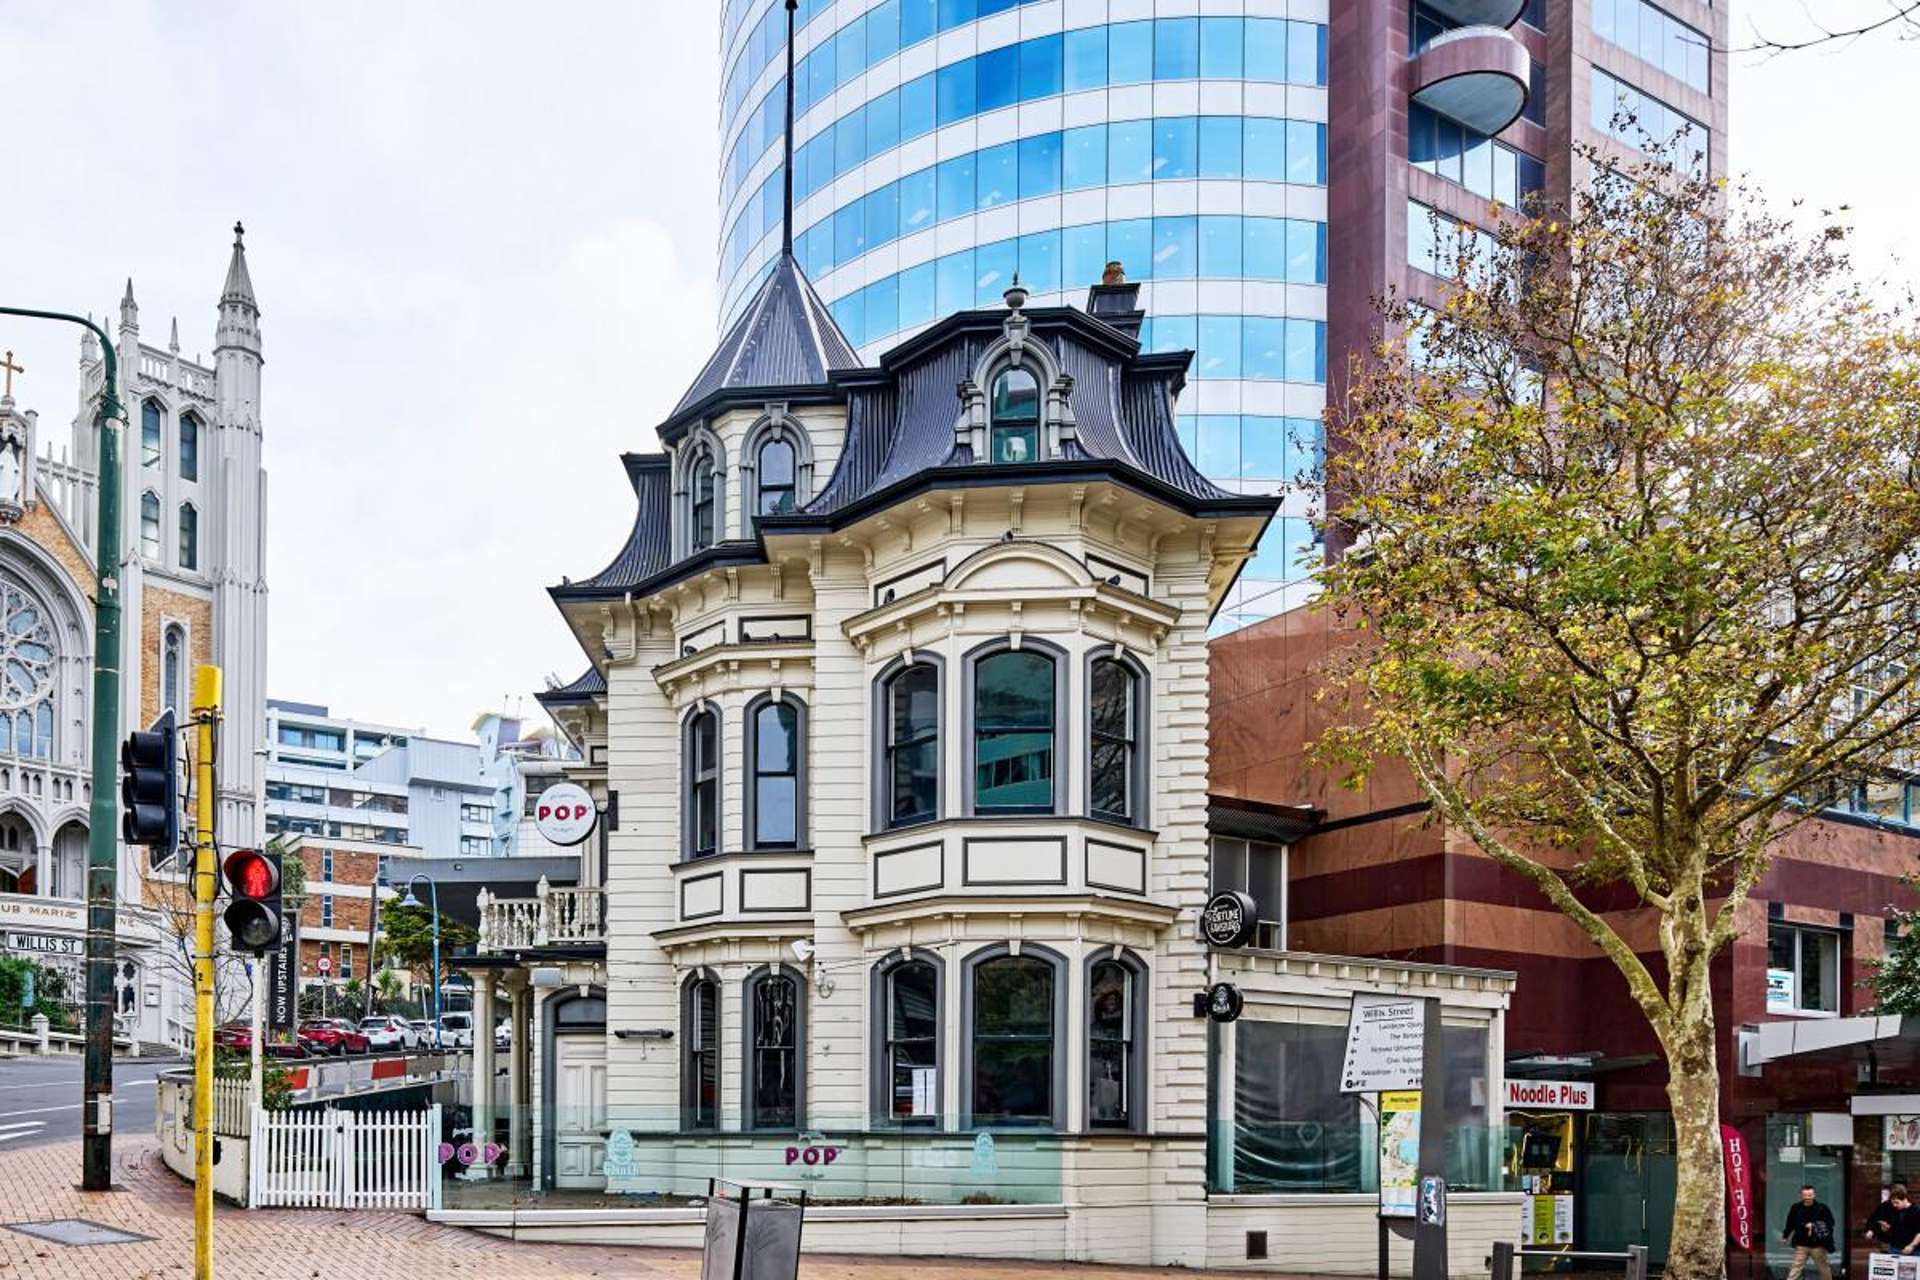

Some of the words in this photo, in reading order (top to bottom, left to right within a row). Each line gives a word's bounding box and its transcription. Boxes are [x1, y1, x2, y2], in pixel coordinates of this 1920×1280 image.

[539, 805, 587, 821] POP
[0, 903, 21, 914] UB
[16, 934, 57, 952] WILLIS
[61, 938, 77, 953] ST
[276, 998, 287, 1024] NOW
[1388, 1007, 1414, 1017] Street
[1510, 1082, 1556, 1104] Noodle
[1560, 1085, 1588, 1105] Plus
[438, 1143, 499, 1165] POP
[785, 1146, 837, 1165] POP
